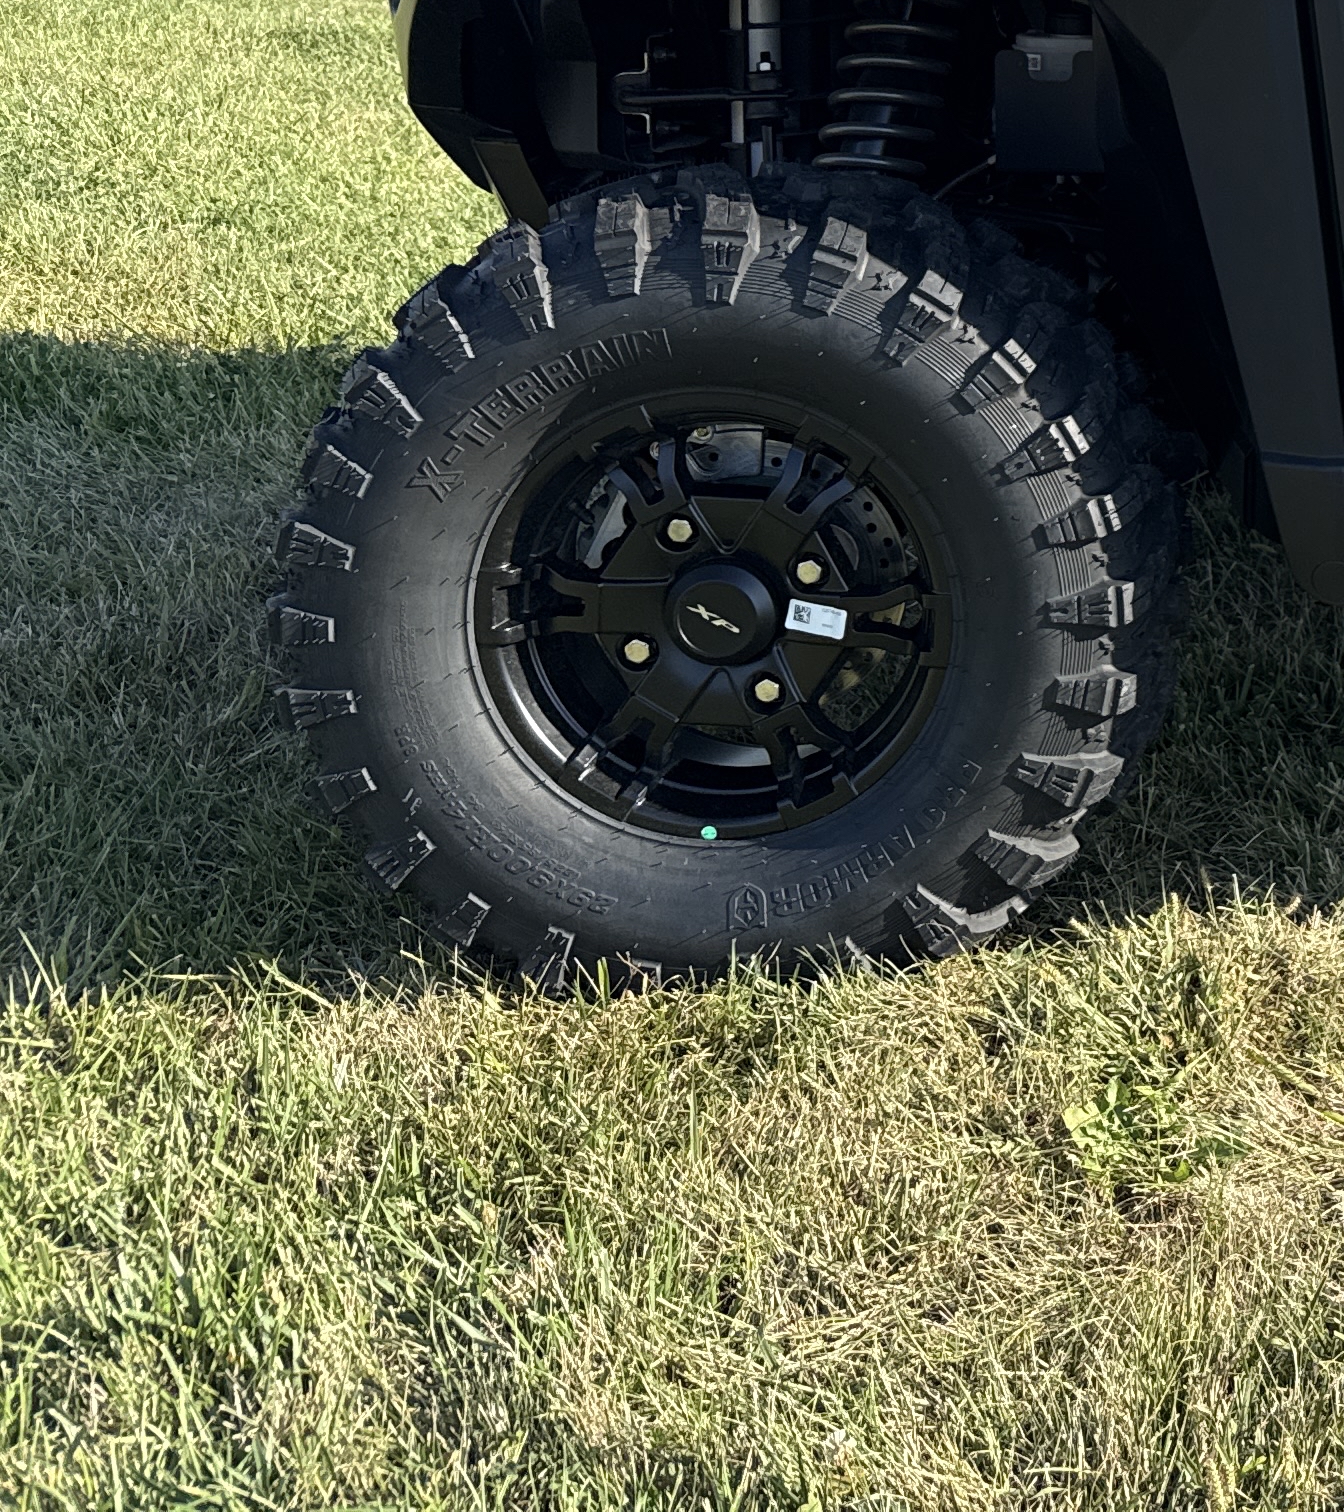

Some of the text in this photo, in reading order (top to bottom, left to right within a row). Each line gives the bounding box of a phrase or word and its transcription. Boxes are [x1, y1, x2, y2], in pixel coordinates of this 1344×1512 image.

[405, 327, 673, 504] X-TERRAIN
[686, 603, 741, 634] XP
[772, 822, 917, 918] ARMOR
